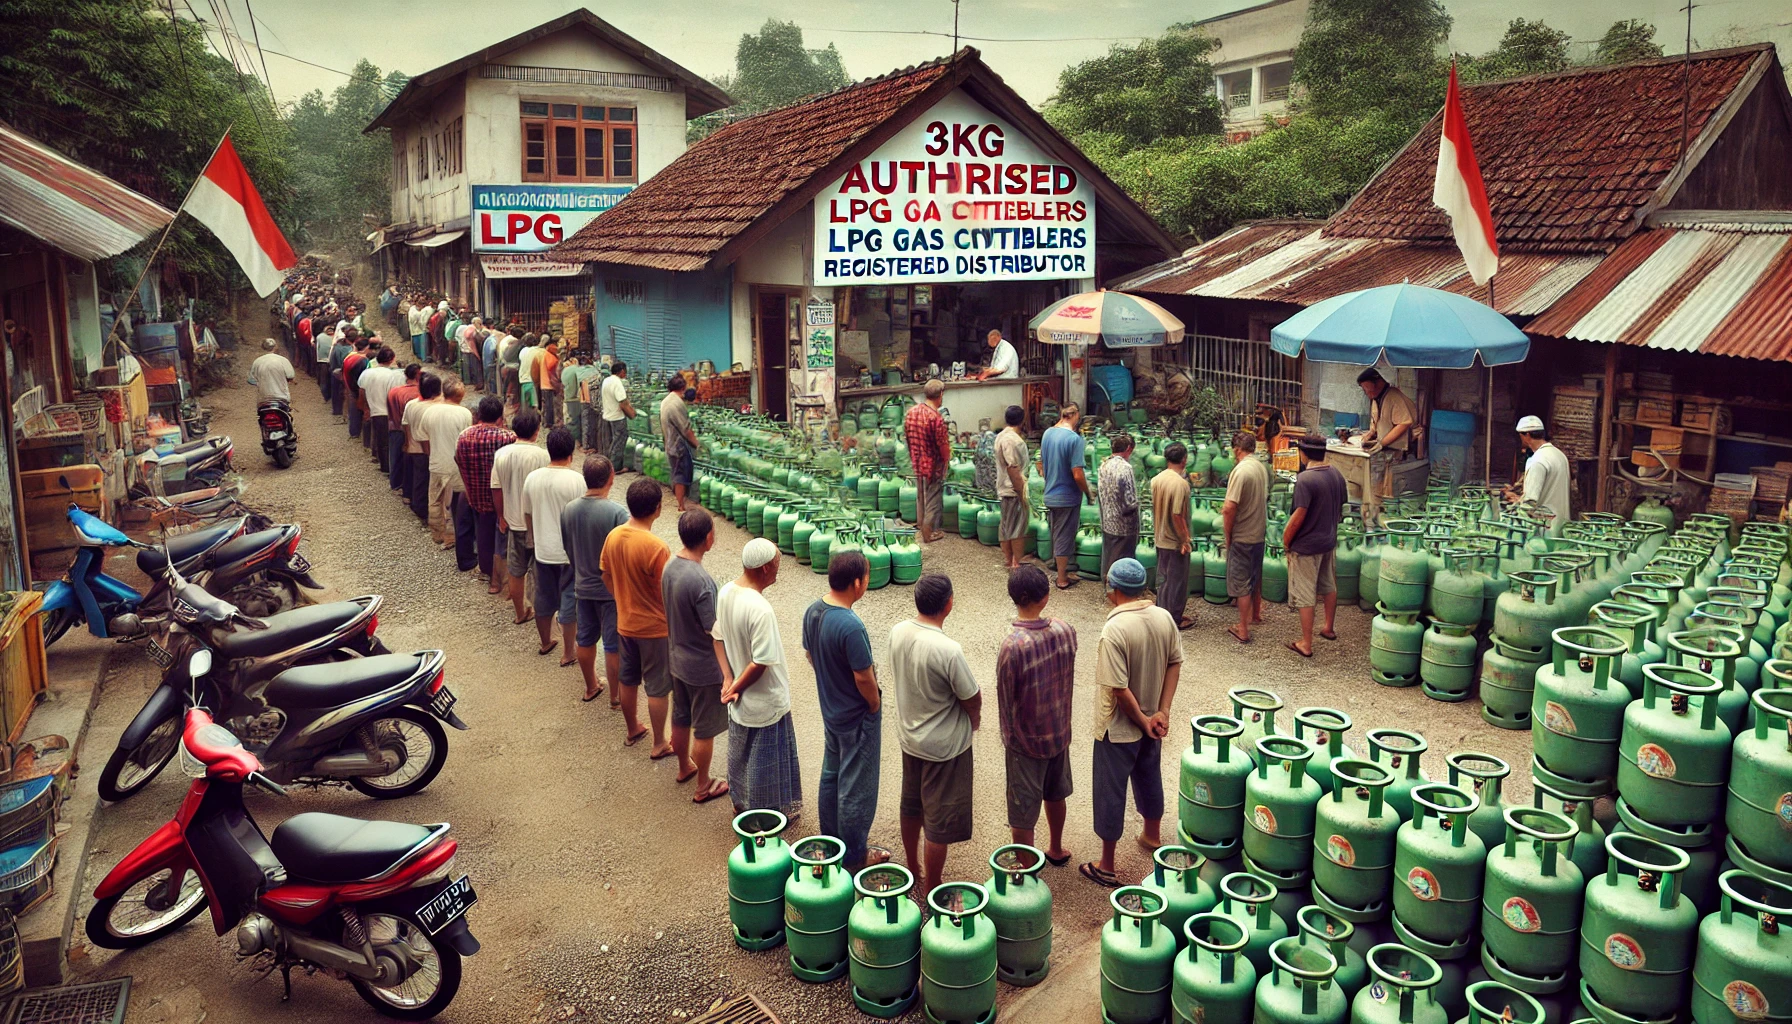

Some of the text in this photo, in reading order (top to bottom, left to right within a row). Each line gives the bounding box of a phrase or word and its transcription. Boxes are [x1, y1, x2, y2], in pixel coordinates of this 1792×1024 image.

[925, 120, 1004, 158] 3KG
[830, 198, 892, 223] LPG
[904, 200, 941, 222] GA
[481, 213, 563, 245] LPG
[829, 228, 883, 253] LPG
[893, 228, 944, 251] GAS
[956, 254, 1086, 275] DISTRIBUTOR
